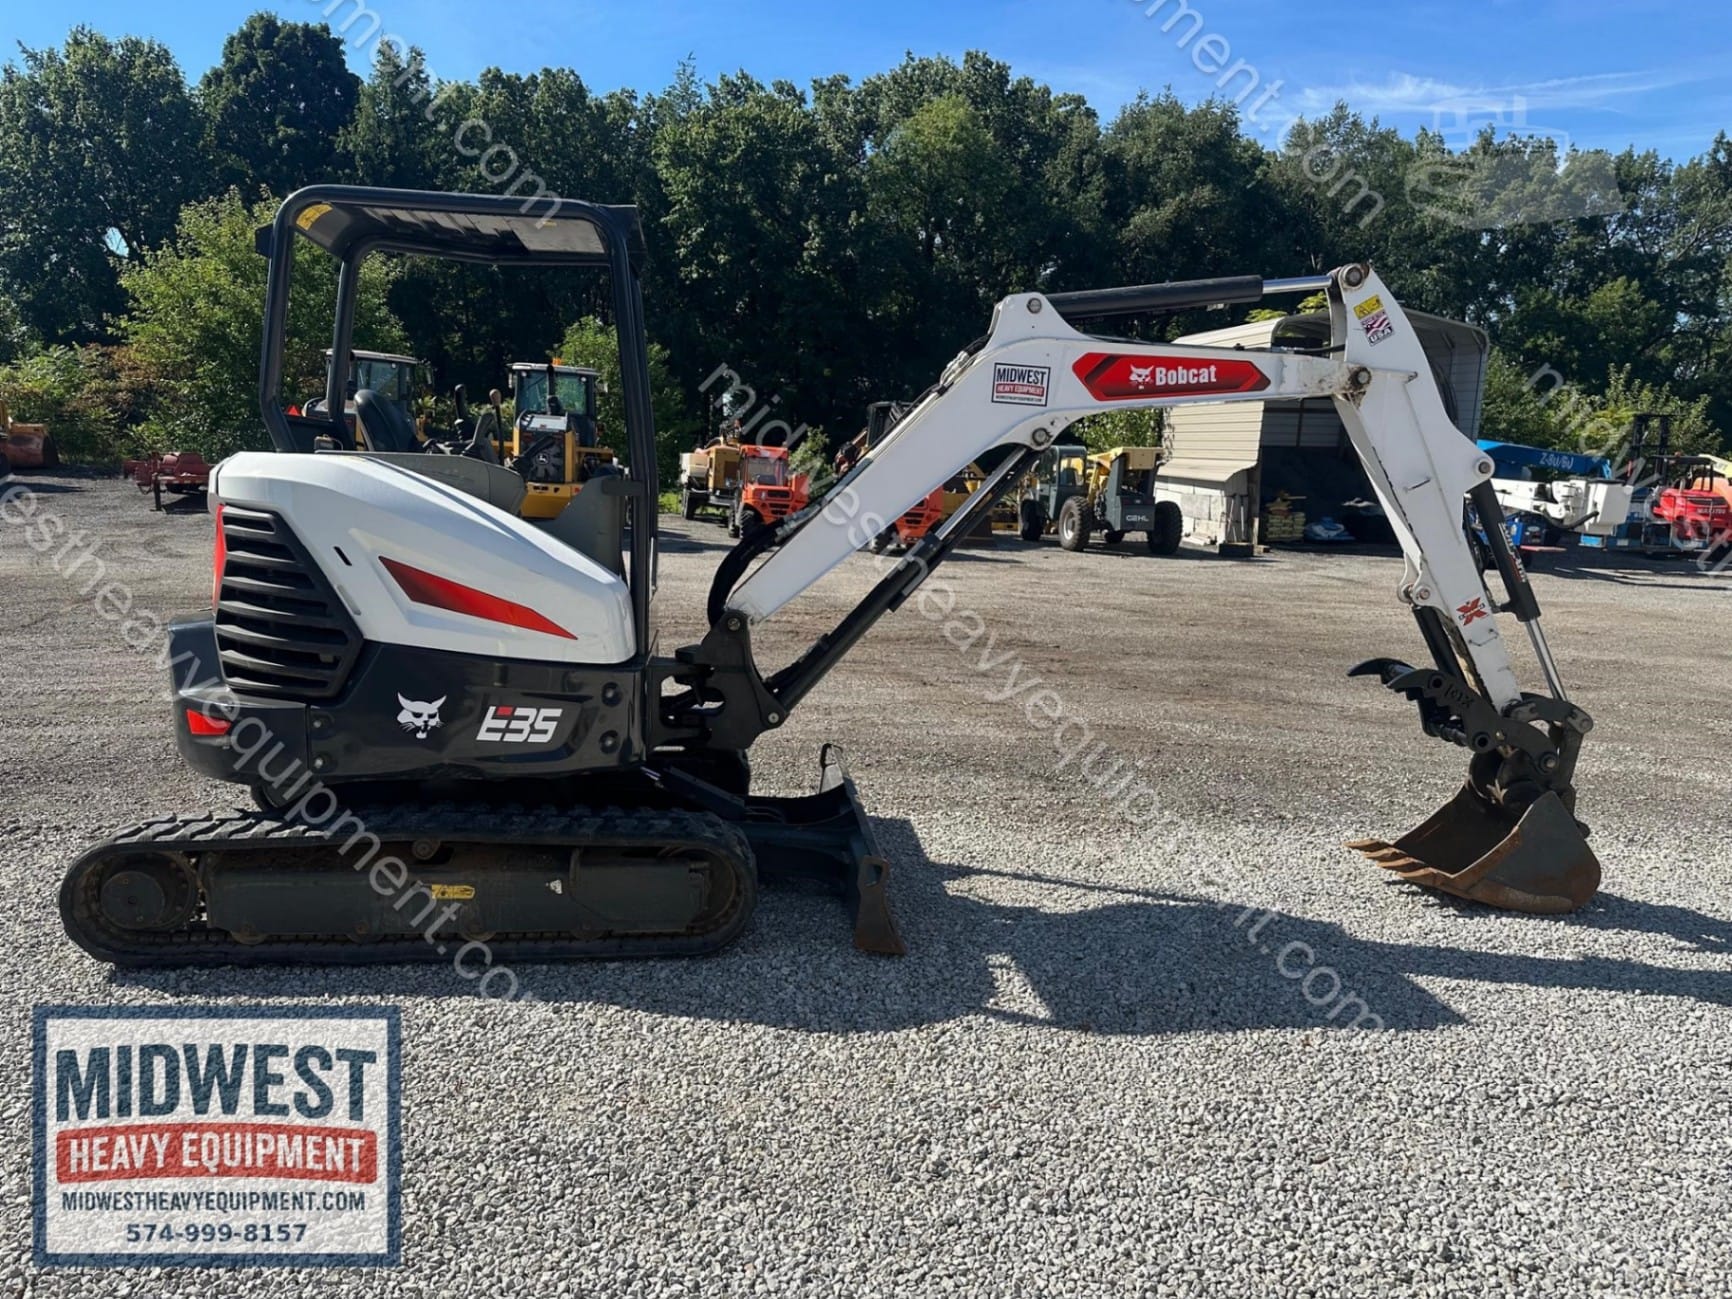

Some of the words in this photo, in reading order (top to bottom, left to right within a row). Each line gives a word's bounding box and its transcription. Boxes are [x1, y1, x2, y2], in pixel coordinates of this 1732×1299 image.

[996, 367, 1047, 386] MIDWEST
[1155, 365, 1217, 386] Bobcat
[996, 384, 1014, 393] HEAVY
[475, 705, 563, 743] E35
